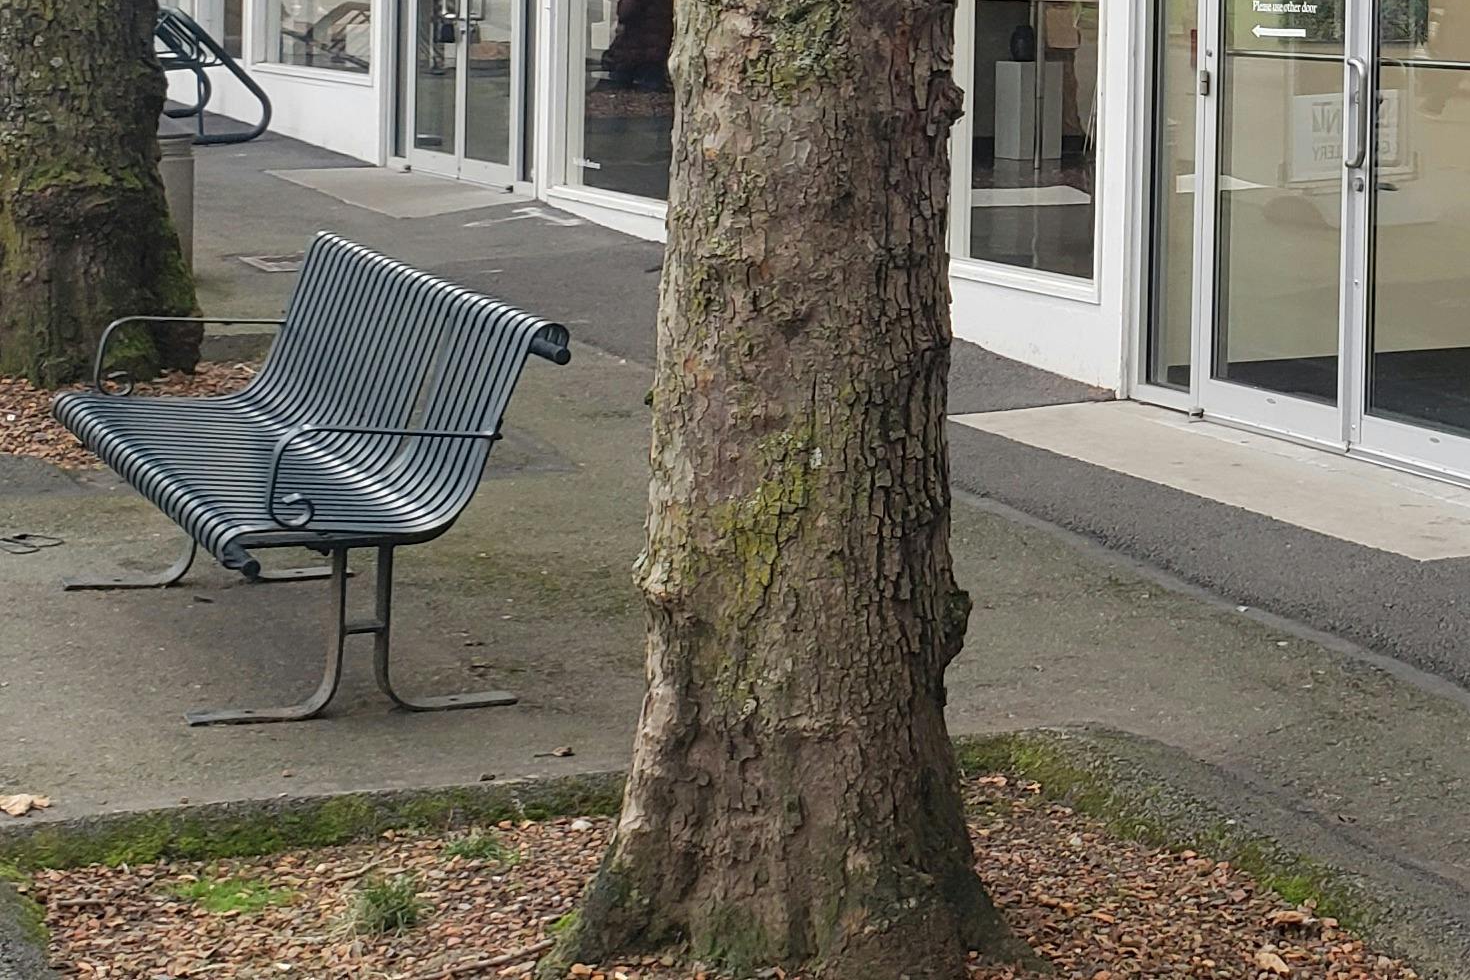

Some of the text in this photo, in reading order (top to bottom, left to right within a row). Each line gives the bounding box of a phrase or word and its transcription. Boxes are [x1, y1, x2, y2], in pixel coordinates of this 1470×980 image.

[1252, 0, 1318, 14] Please use other door
